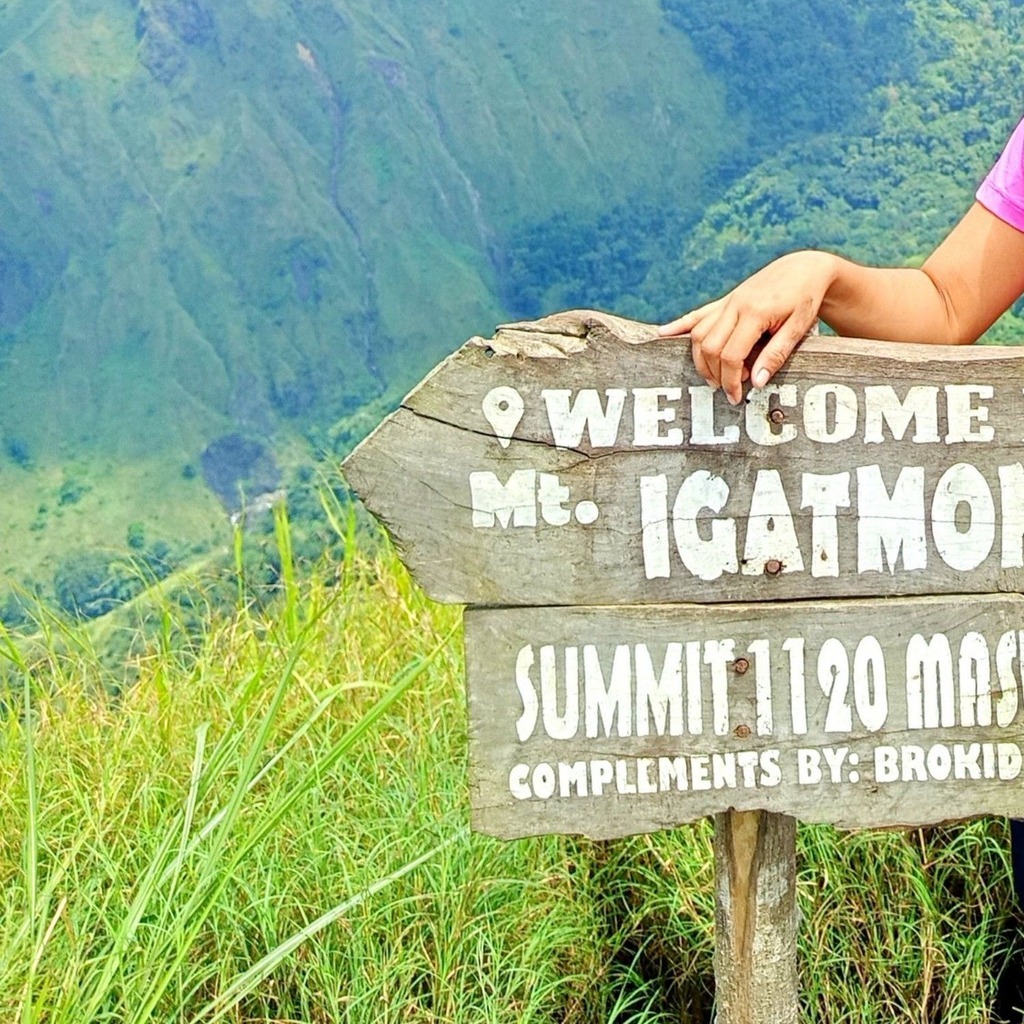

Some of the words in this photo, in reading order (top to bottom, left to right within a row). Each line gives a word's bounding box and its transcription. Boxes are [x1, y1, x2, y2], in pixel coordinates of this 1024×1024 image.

[541, 383, 995, 451] WELCOME
[469, 468, 600, 529] Mt.
[515, 637, 736, 742] SUMMIT
[746, 634, 888, 737] 1120
[508, 749, 782, 800] COMPLEMENTS
[797, 746, 860, 785] BY:
[873, 742, 1023, 783] BROKID
